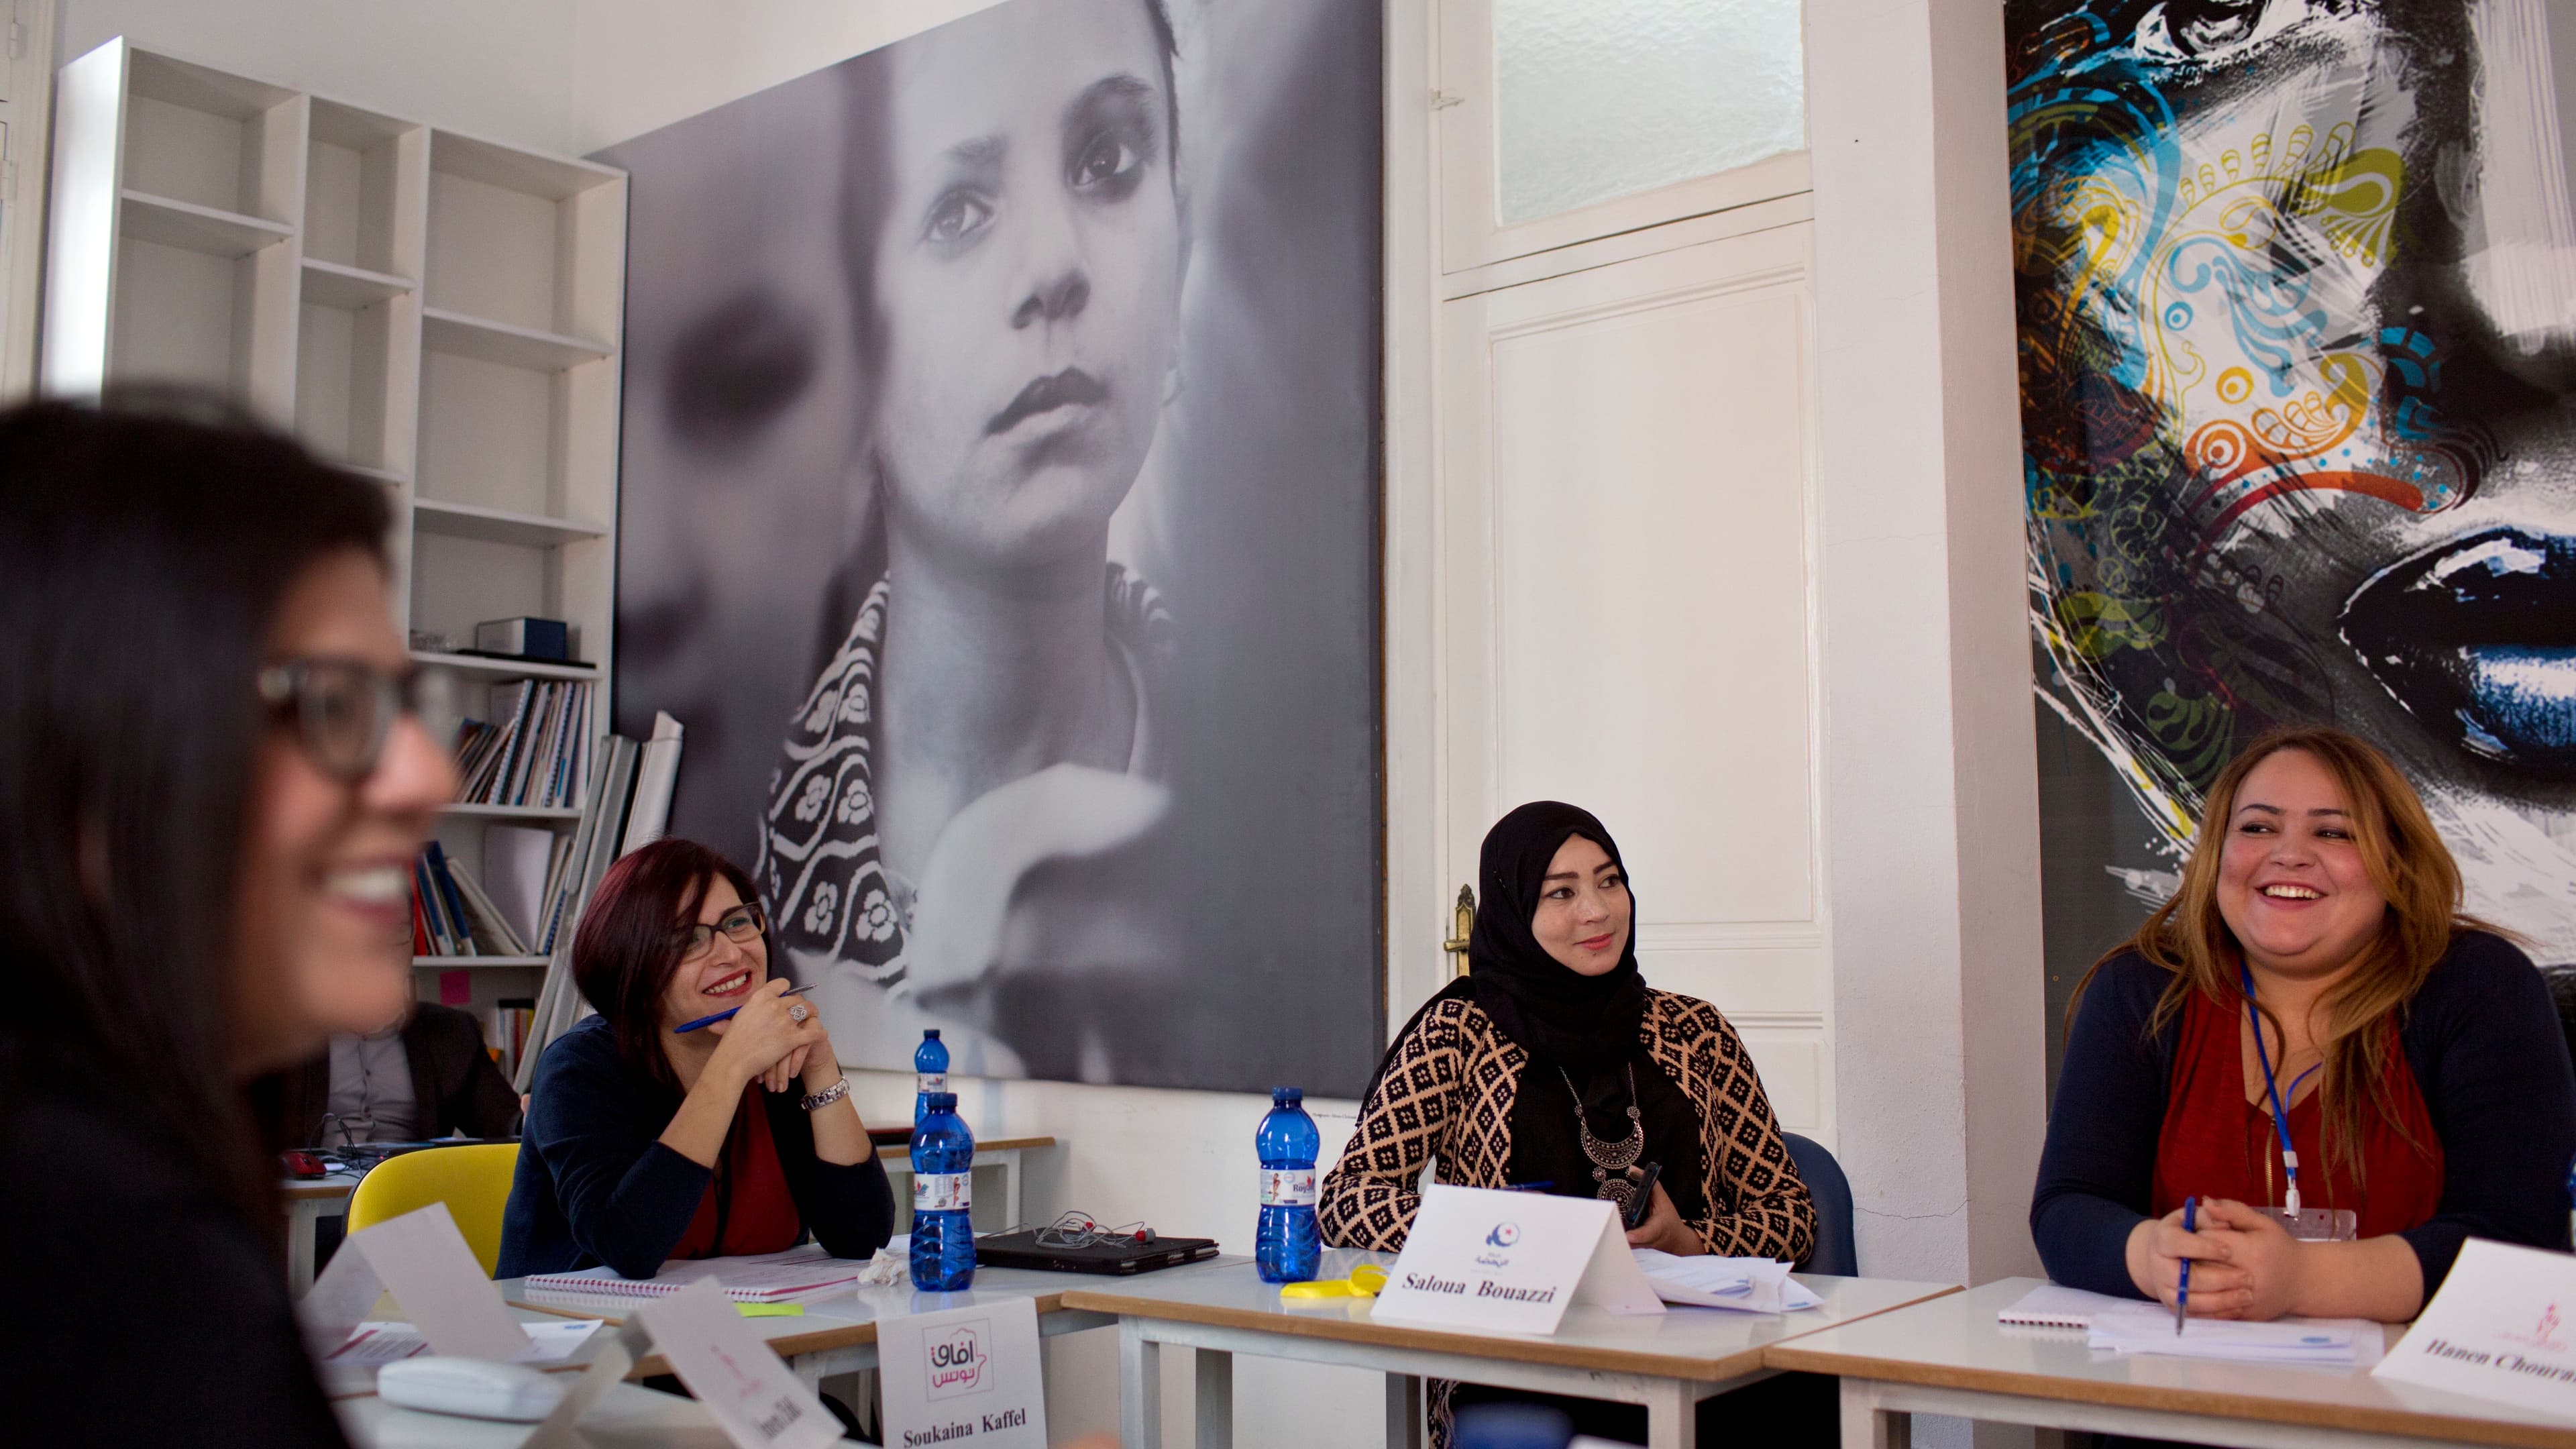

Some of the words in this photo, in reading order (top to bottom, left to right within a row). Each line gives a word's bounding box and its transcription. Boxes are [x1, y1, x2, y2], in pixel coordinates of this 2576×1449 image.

[1402, 1272, 1466, 1295] Saloua
[1477, 1279, 1557, 1304] Bouazzi
[2425, 1338, 2491, 1364] Hanen
[932, 1367, 975, 1389] تونس
[903, 1421, 973, 1449] Soukaina
[981, 1407, 1027, 1434] Kaffel
